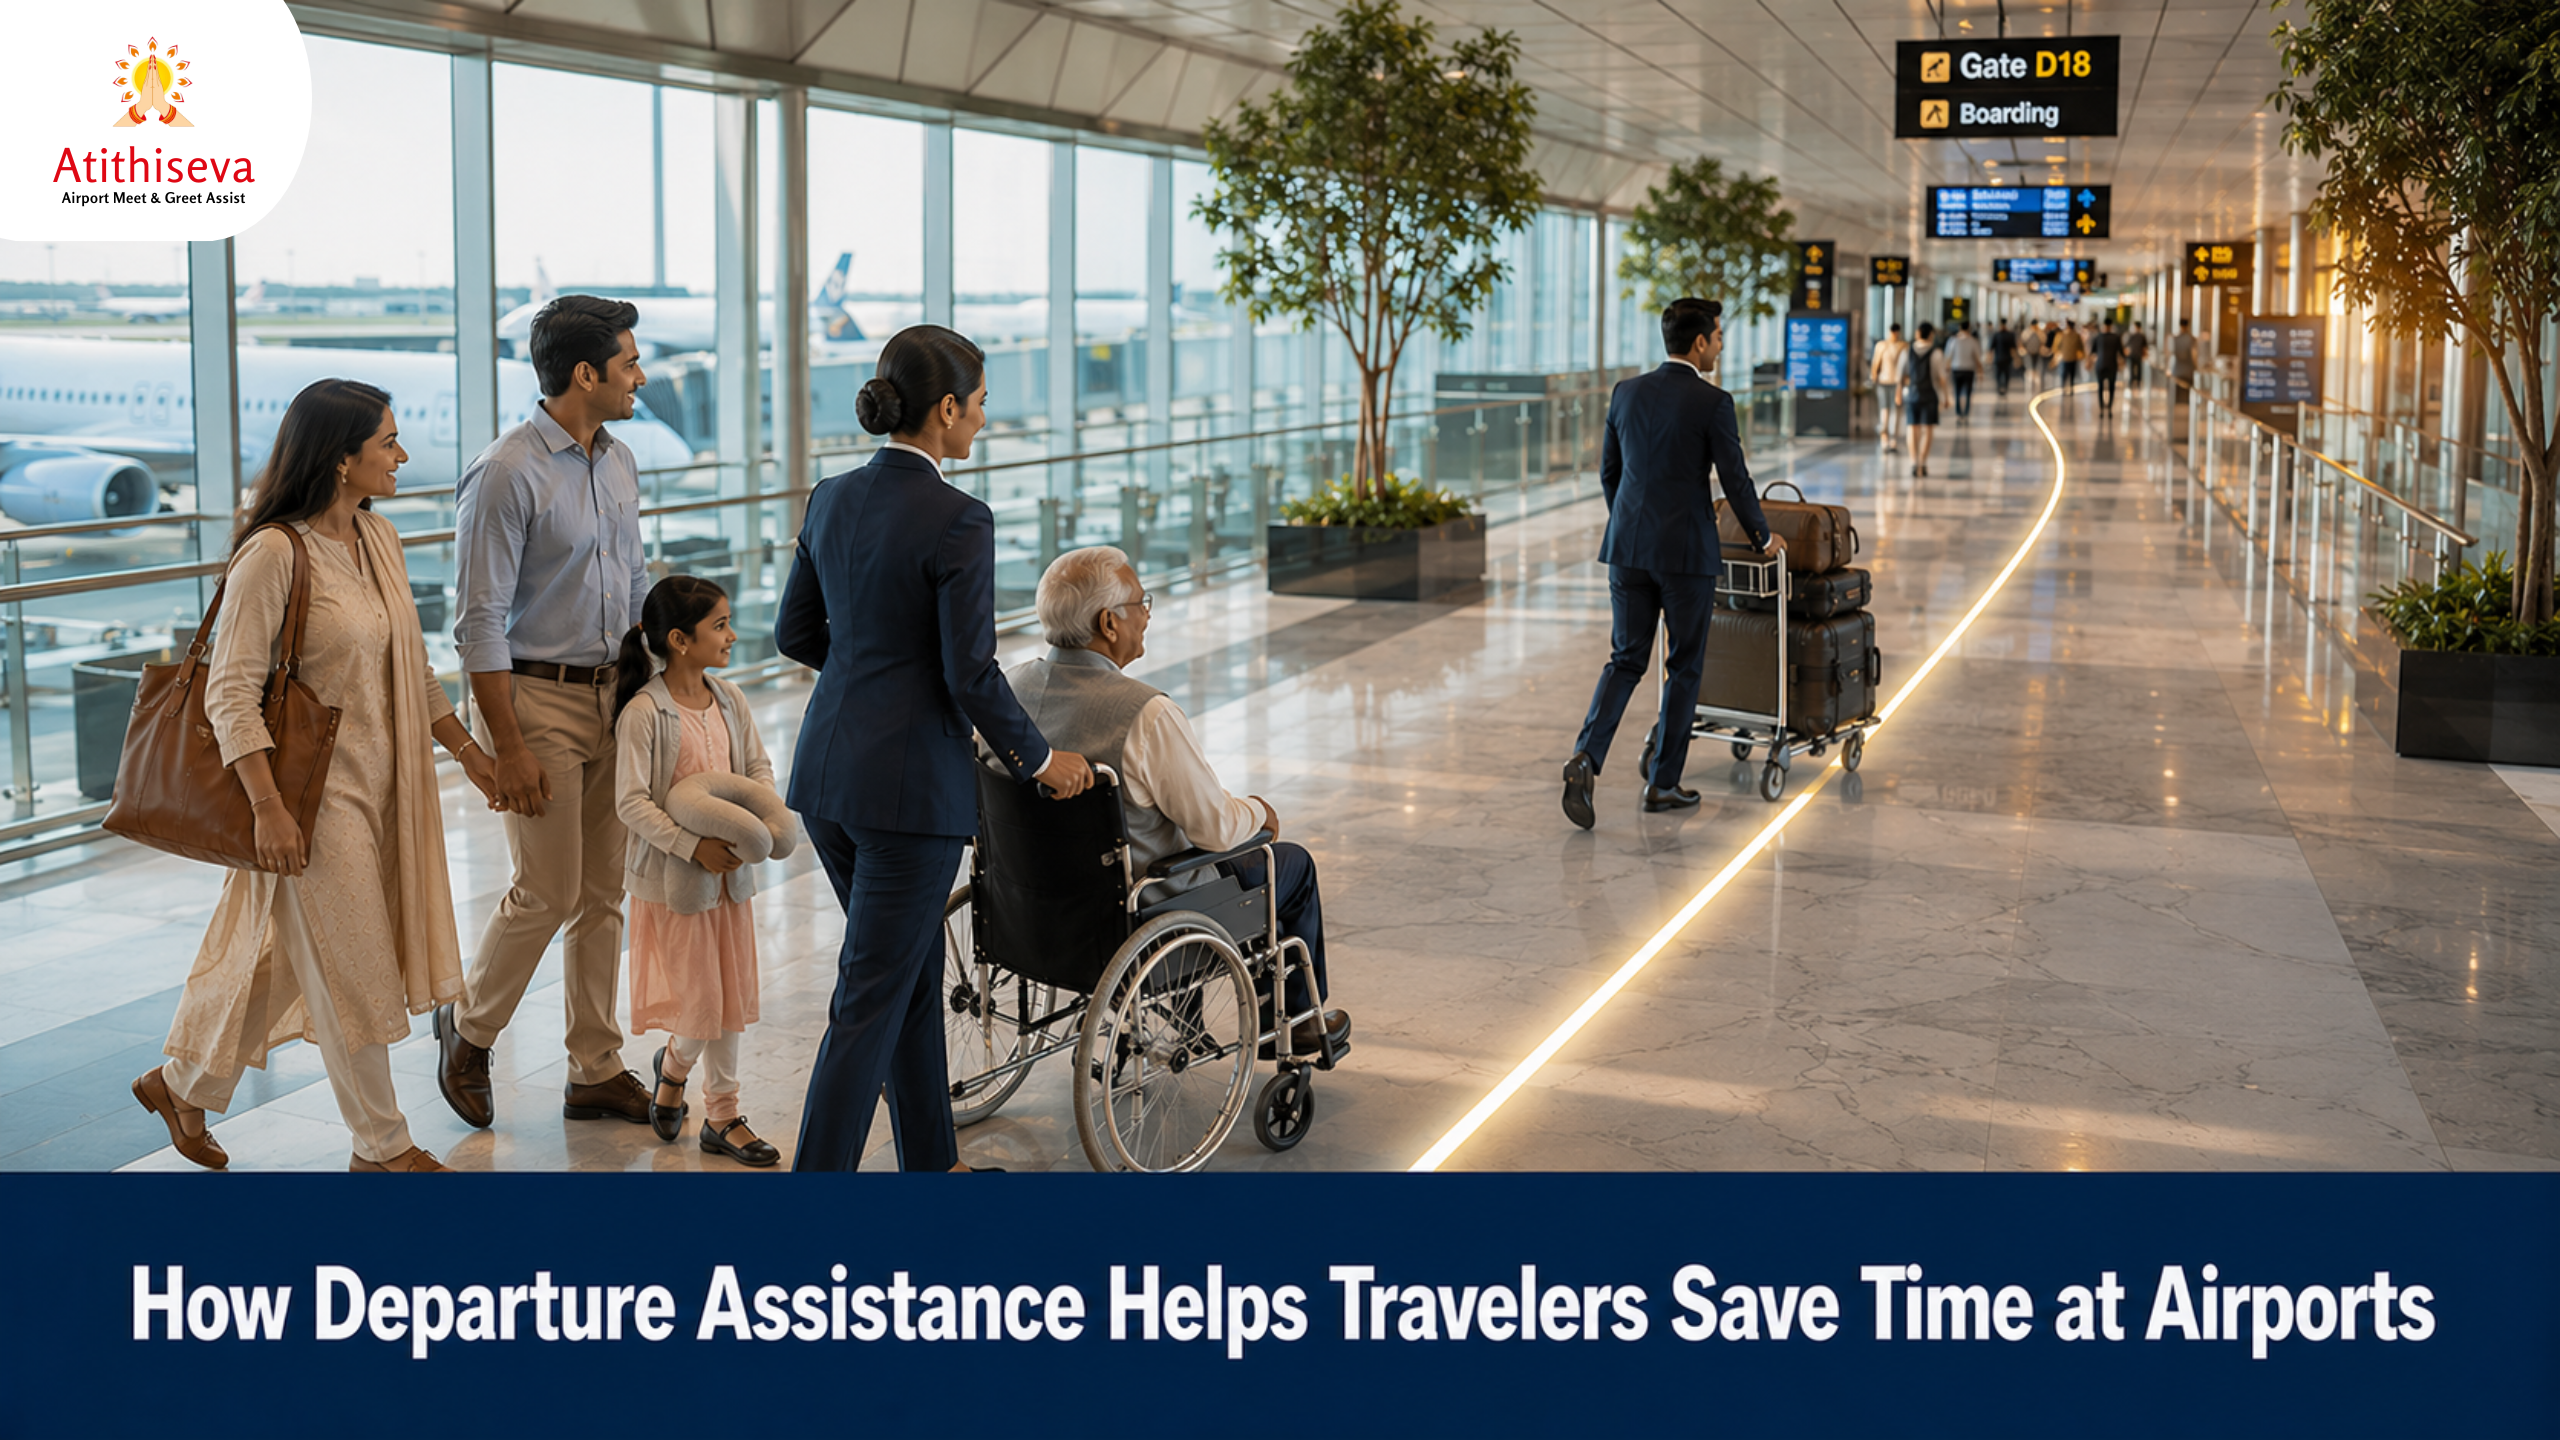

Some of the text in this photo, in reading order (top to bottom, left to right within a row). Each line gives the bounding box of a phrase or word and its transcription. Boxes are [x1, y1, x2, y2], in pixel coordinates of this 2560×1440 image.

[1960, 51, 2092, 79] Gate D18
[1960, 102, 2059, 127] Boarding
